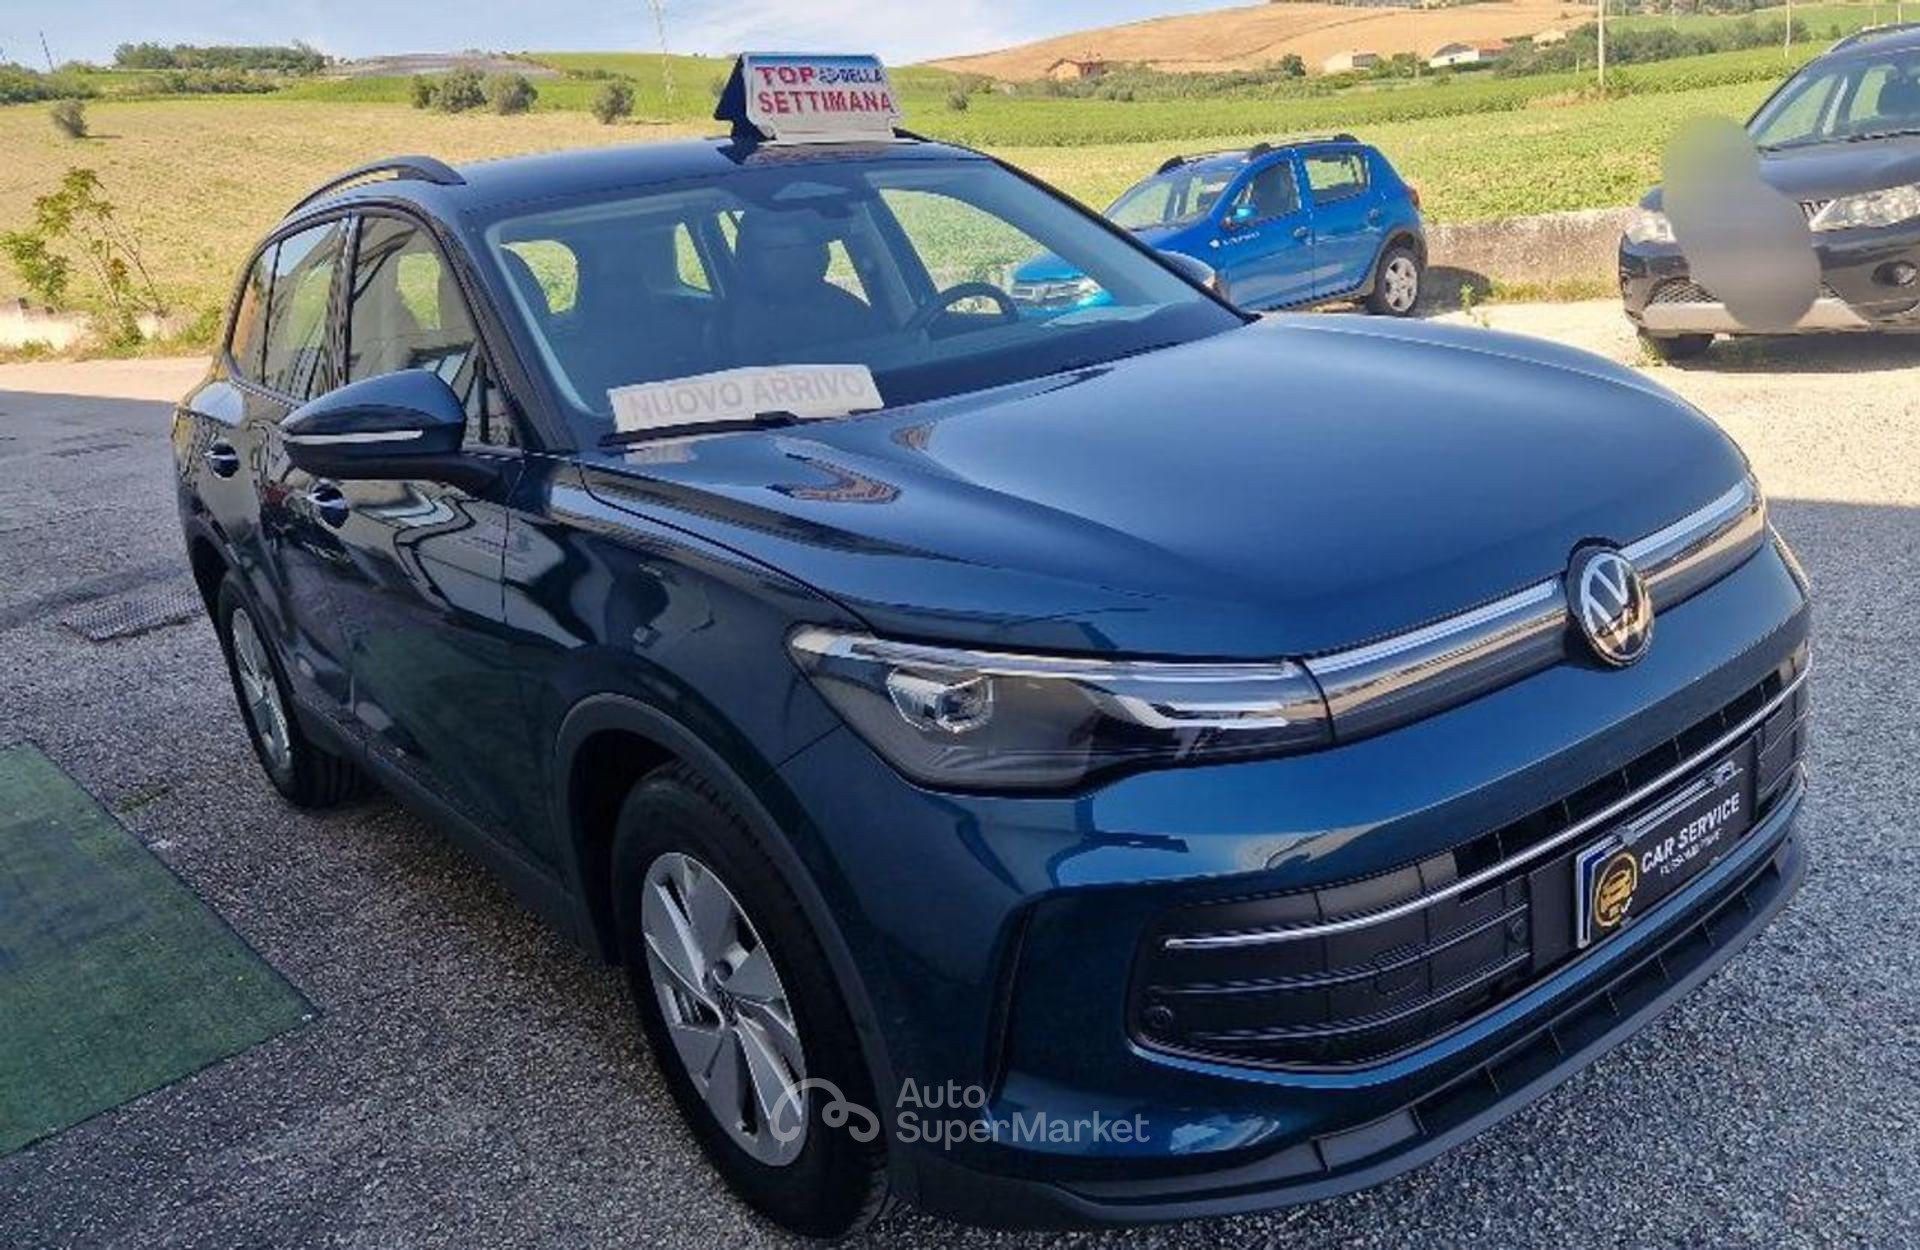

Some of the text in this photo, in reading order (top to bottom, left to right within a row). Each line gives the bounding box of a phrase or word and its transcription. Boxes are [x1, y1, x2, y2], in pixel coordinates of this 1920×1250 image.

[755, 66, 815, 85] TOP
[758, 90, 895, 114] SETTIMANA
[629, 370, 867, 422] NUOVO ARRIVO
[1640, 836, 1675, 874] CAR
[1678, 792, 1741, 849] SERVICE
